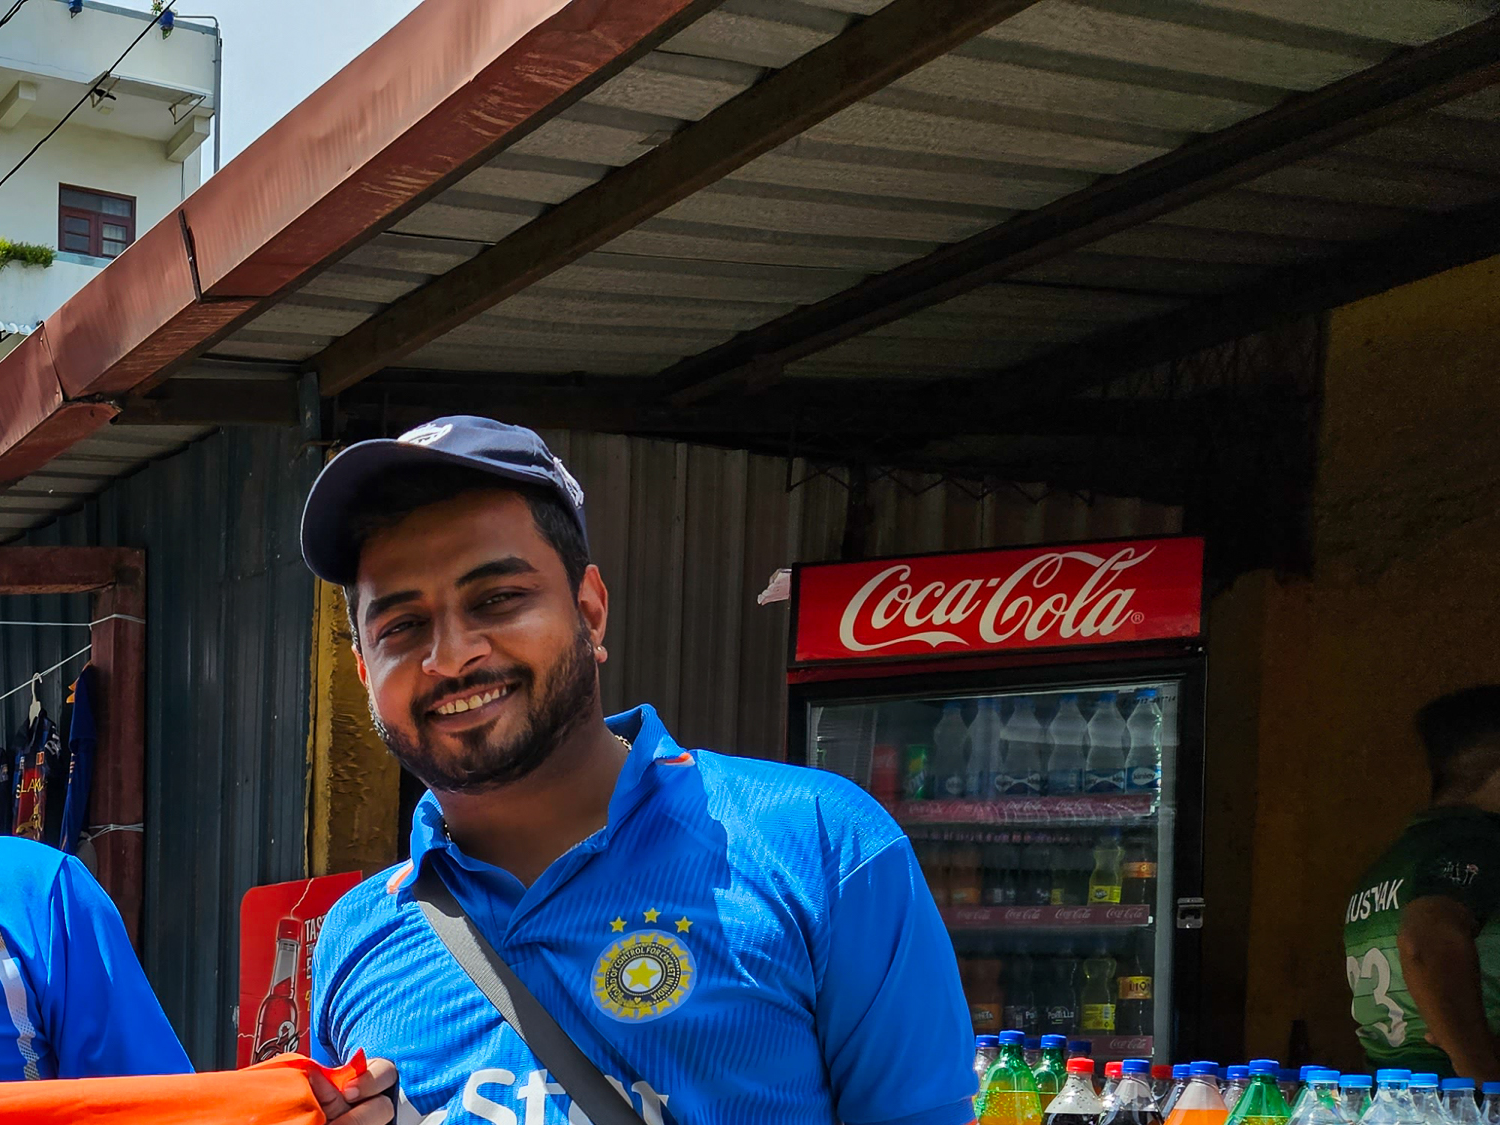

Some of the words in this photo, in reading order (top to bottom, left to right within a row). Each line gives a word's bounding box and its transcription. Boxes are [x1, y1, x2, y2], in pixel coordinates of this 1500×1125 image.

[839, 546, 1156, 652] Coca-Cola
[615, 948, 646, 968] CONTROL
[646, 947, 661, 957] FOR
